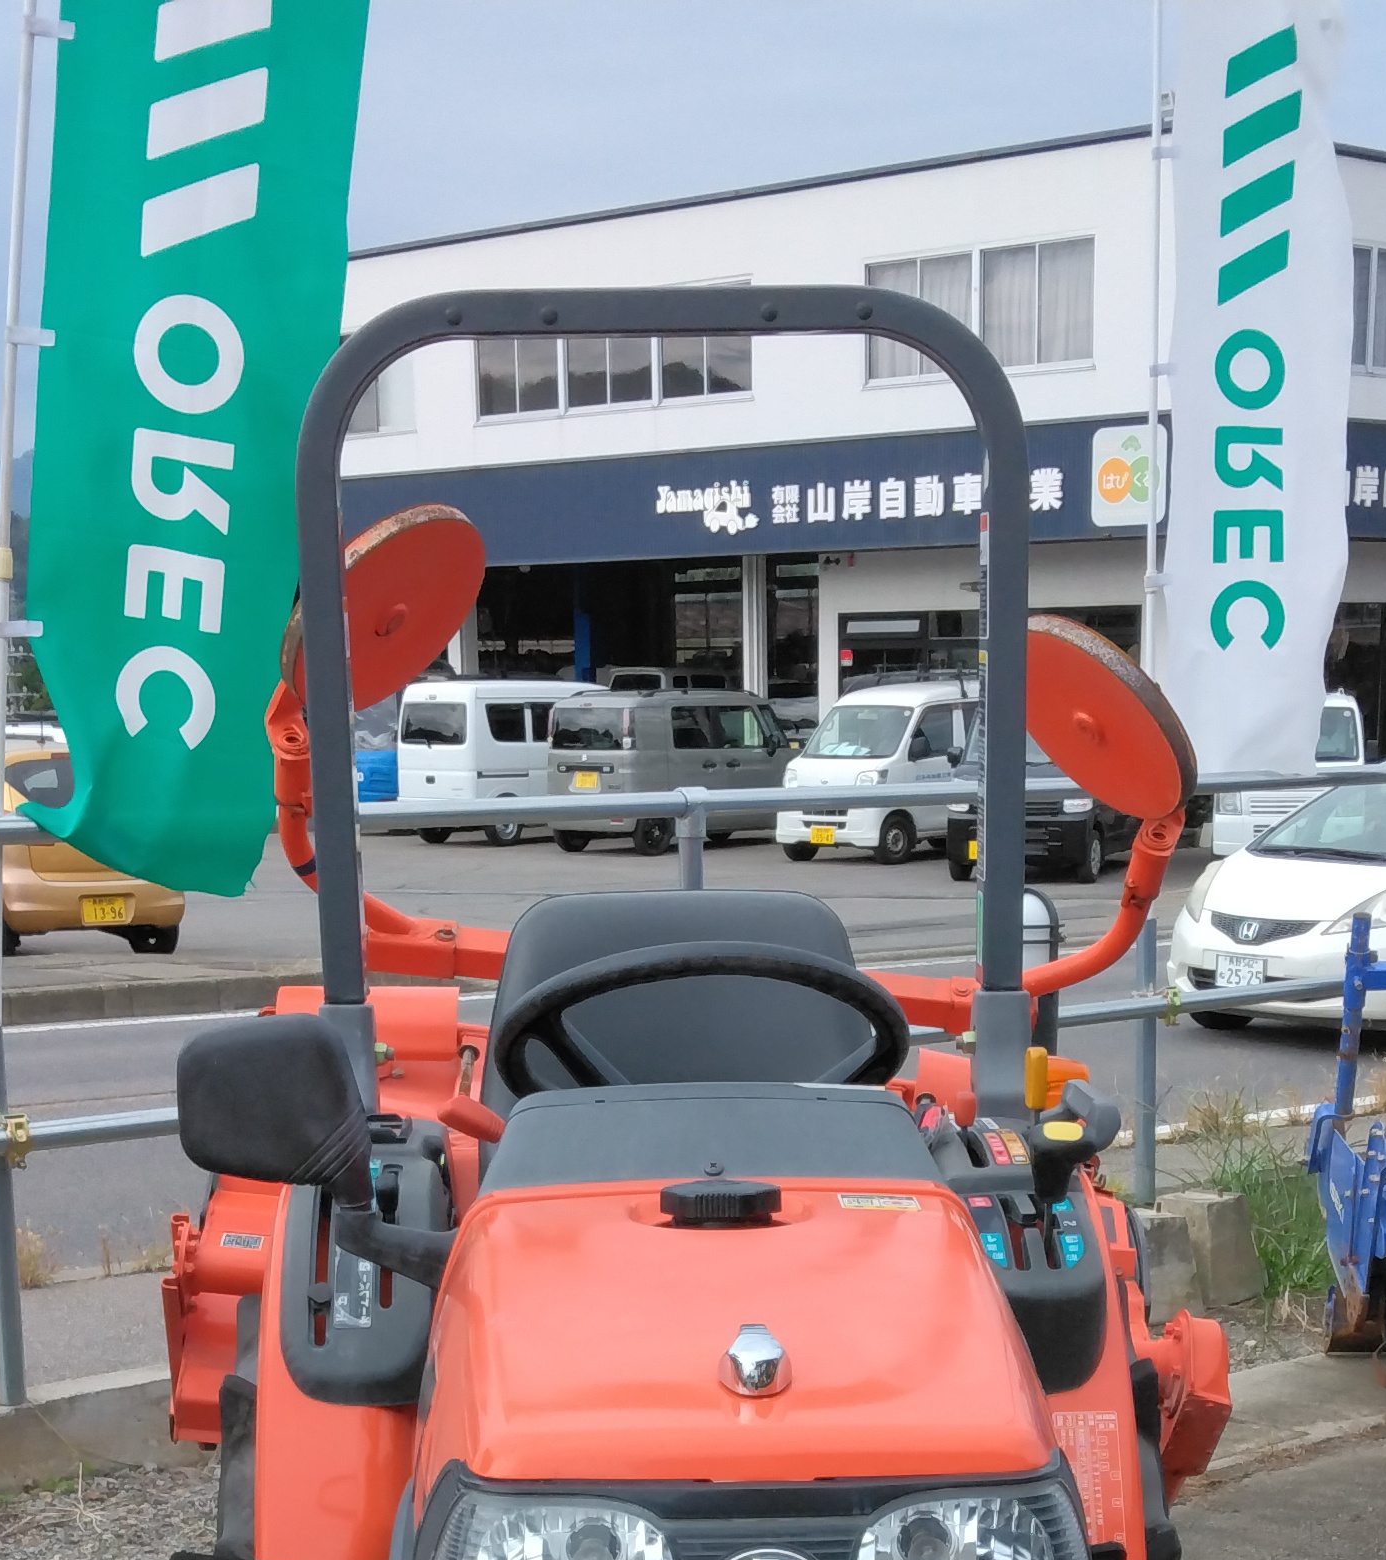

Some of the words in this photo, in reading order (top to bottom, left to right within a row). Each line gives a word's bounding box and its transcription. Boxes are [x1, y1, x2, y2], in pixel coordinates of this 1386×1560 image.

[656, 479, 752, 515] Yamagishi
[806, 467, 1064, 524] 山岸自動車業
